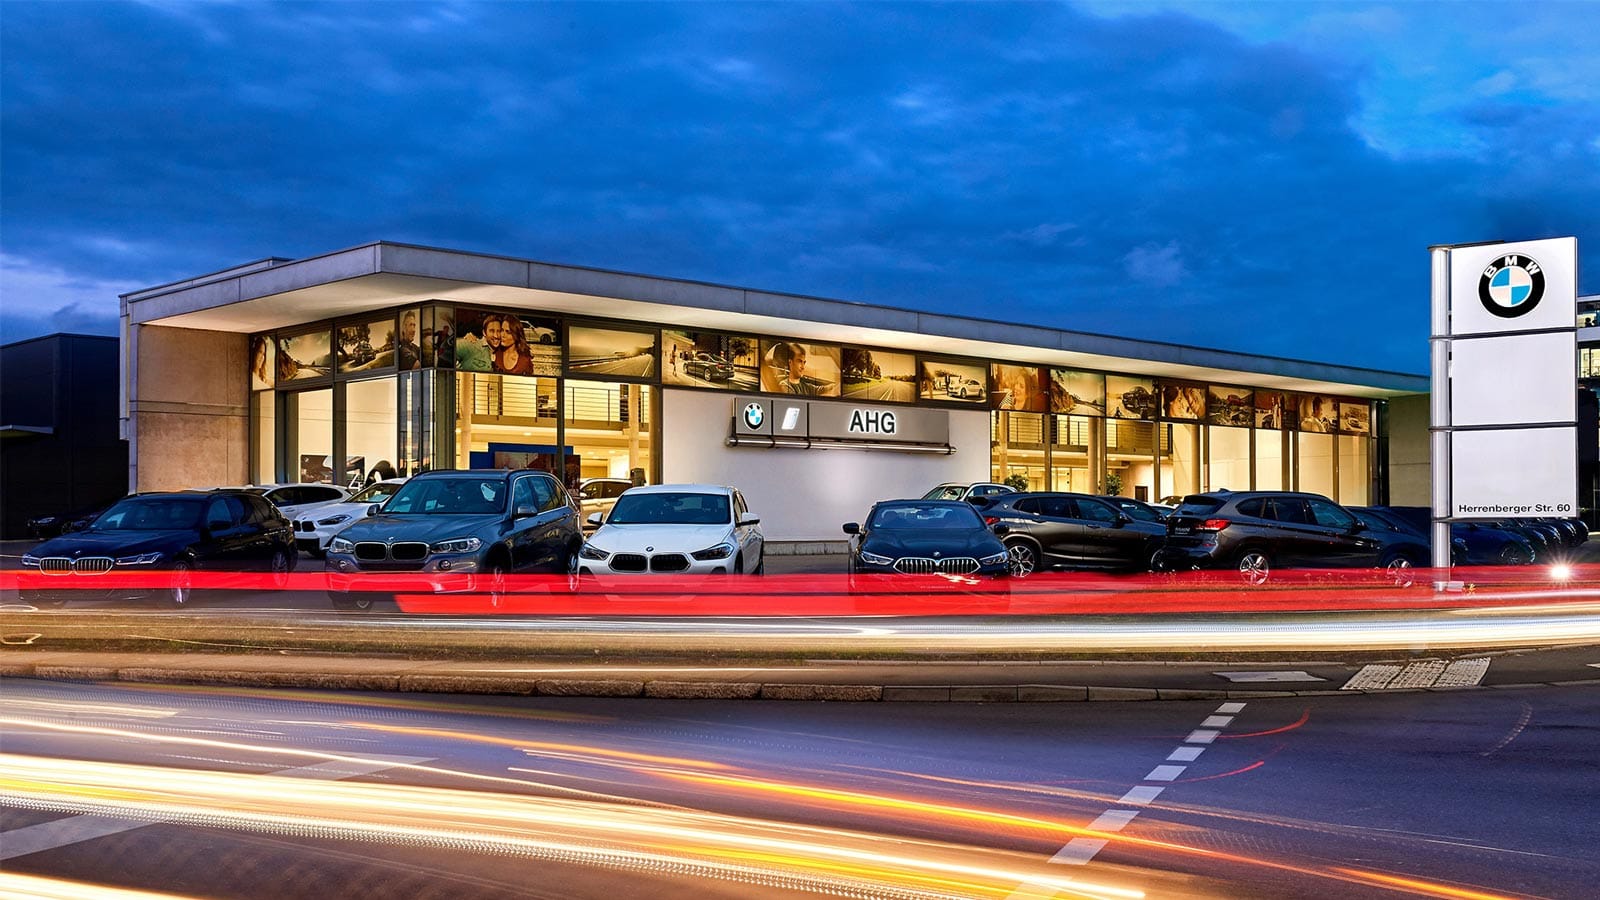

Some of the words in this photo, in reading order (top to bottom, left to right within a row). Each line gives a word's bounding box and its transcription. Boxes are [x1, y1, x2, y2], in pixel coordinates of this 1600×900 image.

[1484, 255, 1540, 278] BMW
[849, 410, 896, 434] AHG
[1458, 504, 1531, 514] Herrenberger
[1535, 503, 1554, 512] Str.
[1556, 503, 1571, 512] 60
